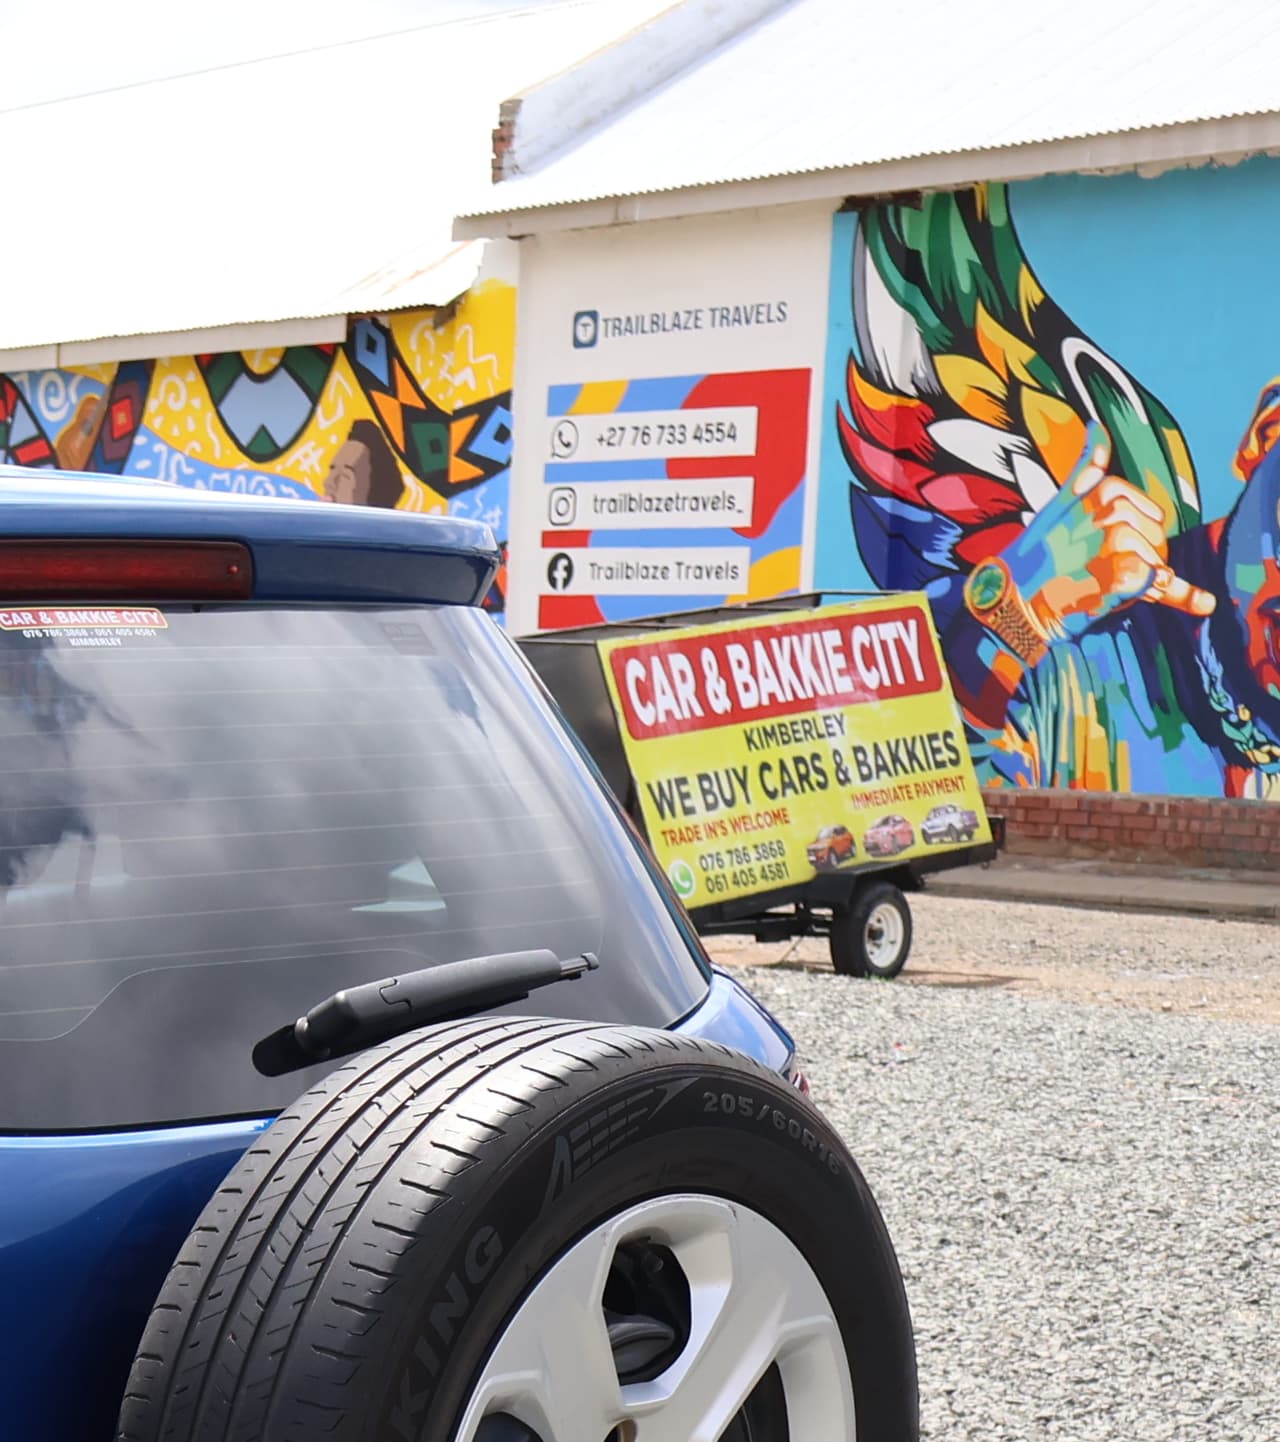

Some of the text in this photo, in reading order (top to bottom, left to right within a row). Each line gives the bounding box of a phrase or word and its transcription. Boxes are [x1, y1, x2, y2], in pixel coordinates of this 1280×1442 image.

[602, 301, 788, 338] TRAILBLAZE TRAVELS
[597, 422, 738, 447] +27 76 733 4554
[589, 560, 739, 580] Trailblaze Travels
[39, 612, 53, 624] &
[55, 611, 120, 624] BAKKIE
[122, 612, 160, 624] CITY
[69, 638, 122, 646] KIMBERLEY
[625, 618, 927, 728] CAR & BAKKIE CITY
[744, 713, 849, 752] KIMBERLEY
[647, 731, 962, 820] WE BUY CARS & BAKKIES
[851, 776, 966, 810] IMMEDIATE PAYMENT
[661, 808, 791, 848] TRADE IN'S WELCOME
[699, 840, 786, 872] 076 786 3868
[705, 861, 790, 893] 061 405 4581
[702, 1089, 843, 1178] 205/60R16
